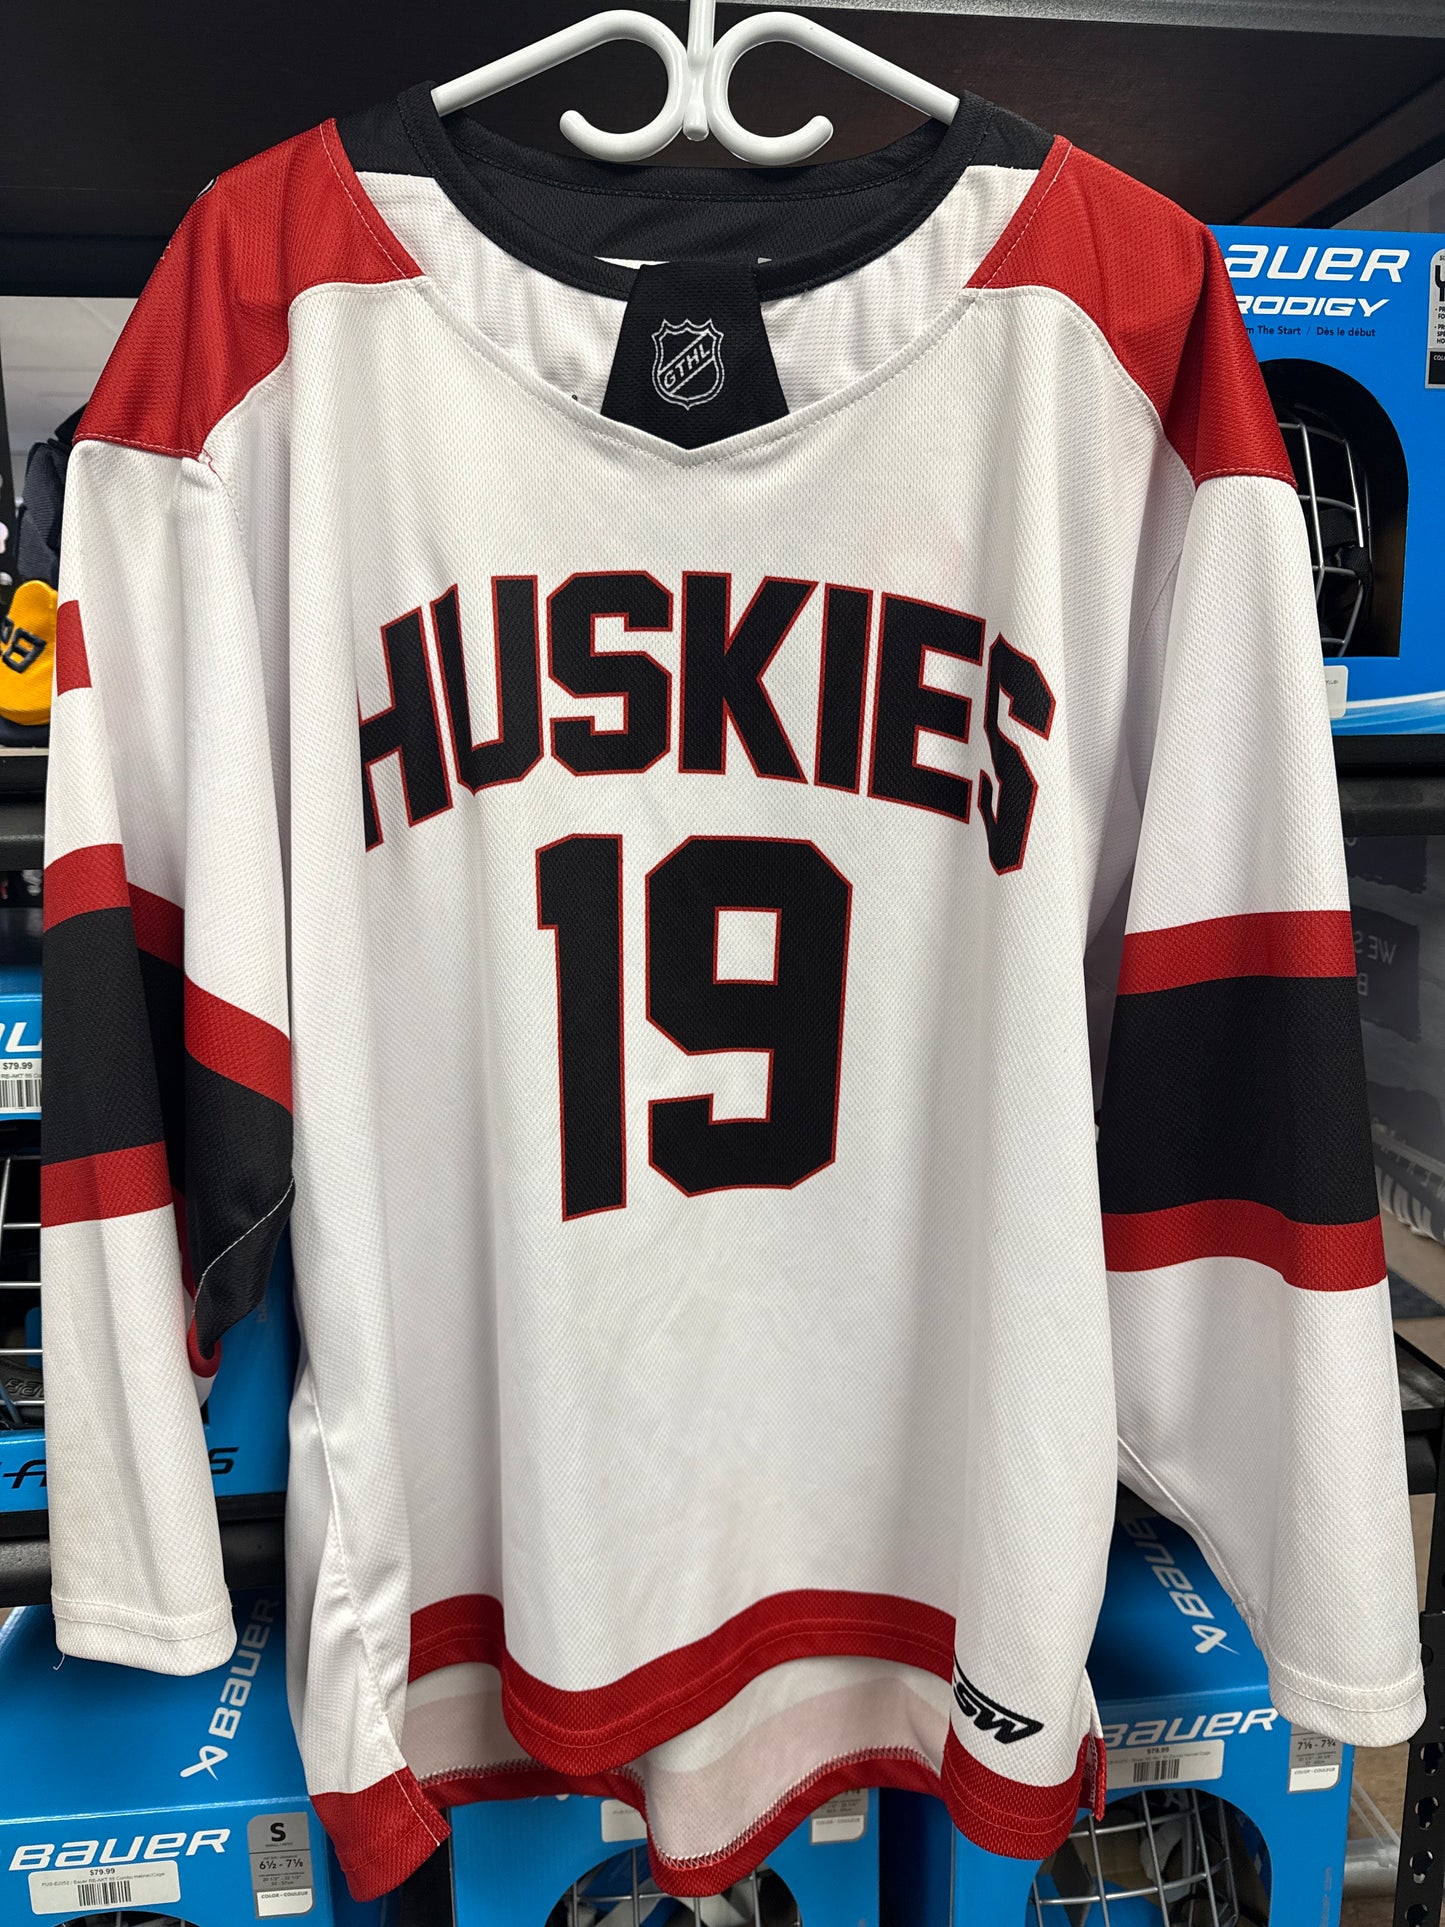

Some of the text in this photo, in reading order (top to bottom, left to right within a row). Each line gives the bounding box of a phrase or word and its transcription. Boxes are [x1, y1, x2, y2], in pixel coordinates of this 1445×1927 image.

[1224, 244, 1410, 283] AUER
[1236, 295, 1390, 317] RODIGY
[1257, 325, 1275, 334] The
[1278, 325, 1301, 335] Start
[1317, 326, 1334, 336] Dès
[1337, 327, 1345, 336] le
[1348, 327, 1376, 337] début
[663, 343, 711, 389] GTHL
[356, 570, 1056, 875] HUSKIES
[535, 833, 853, 1222] 19
[3, 1062, 33, 1070] $79.99
[270, 1822, 286, 1842] S
[89, 1867, 116, 1876] $79.99
